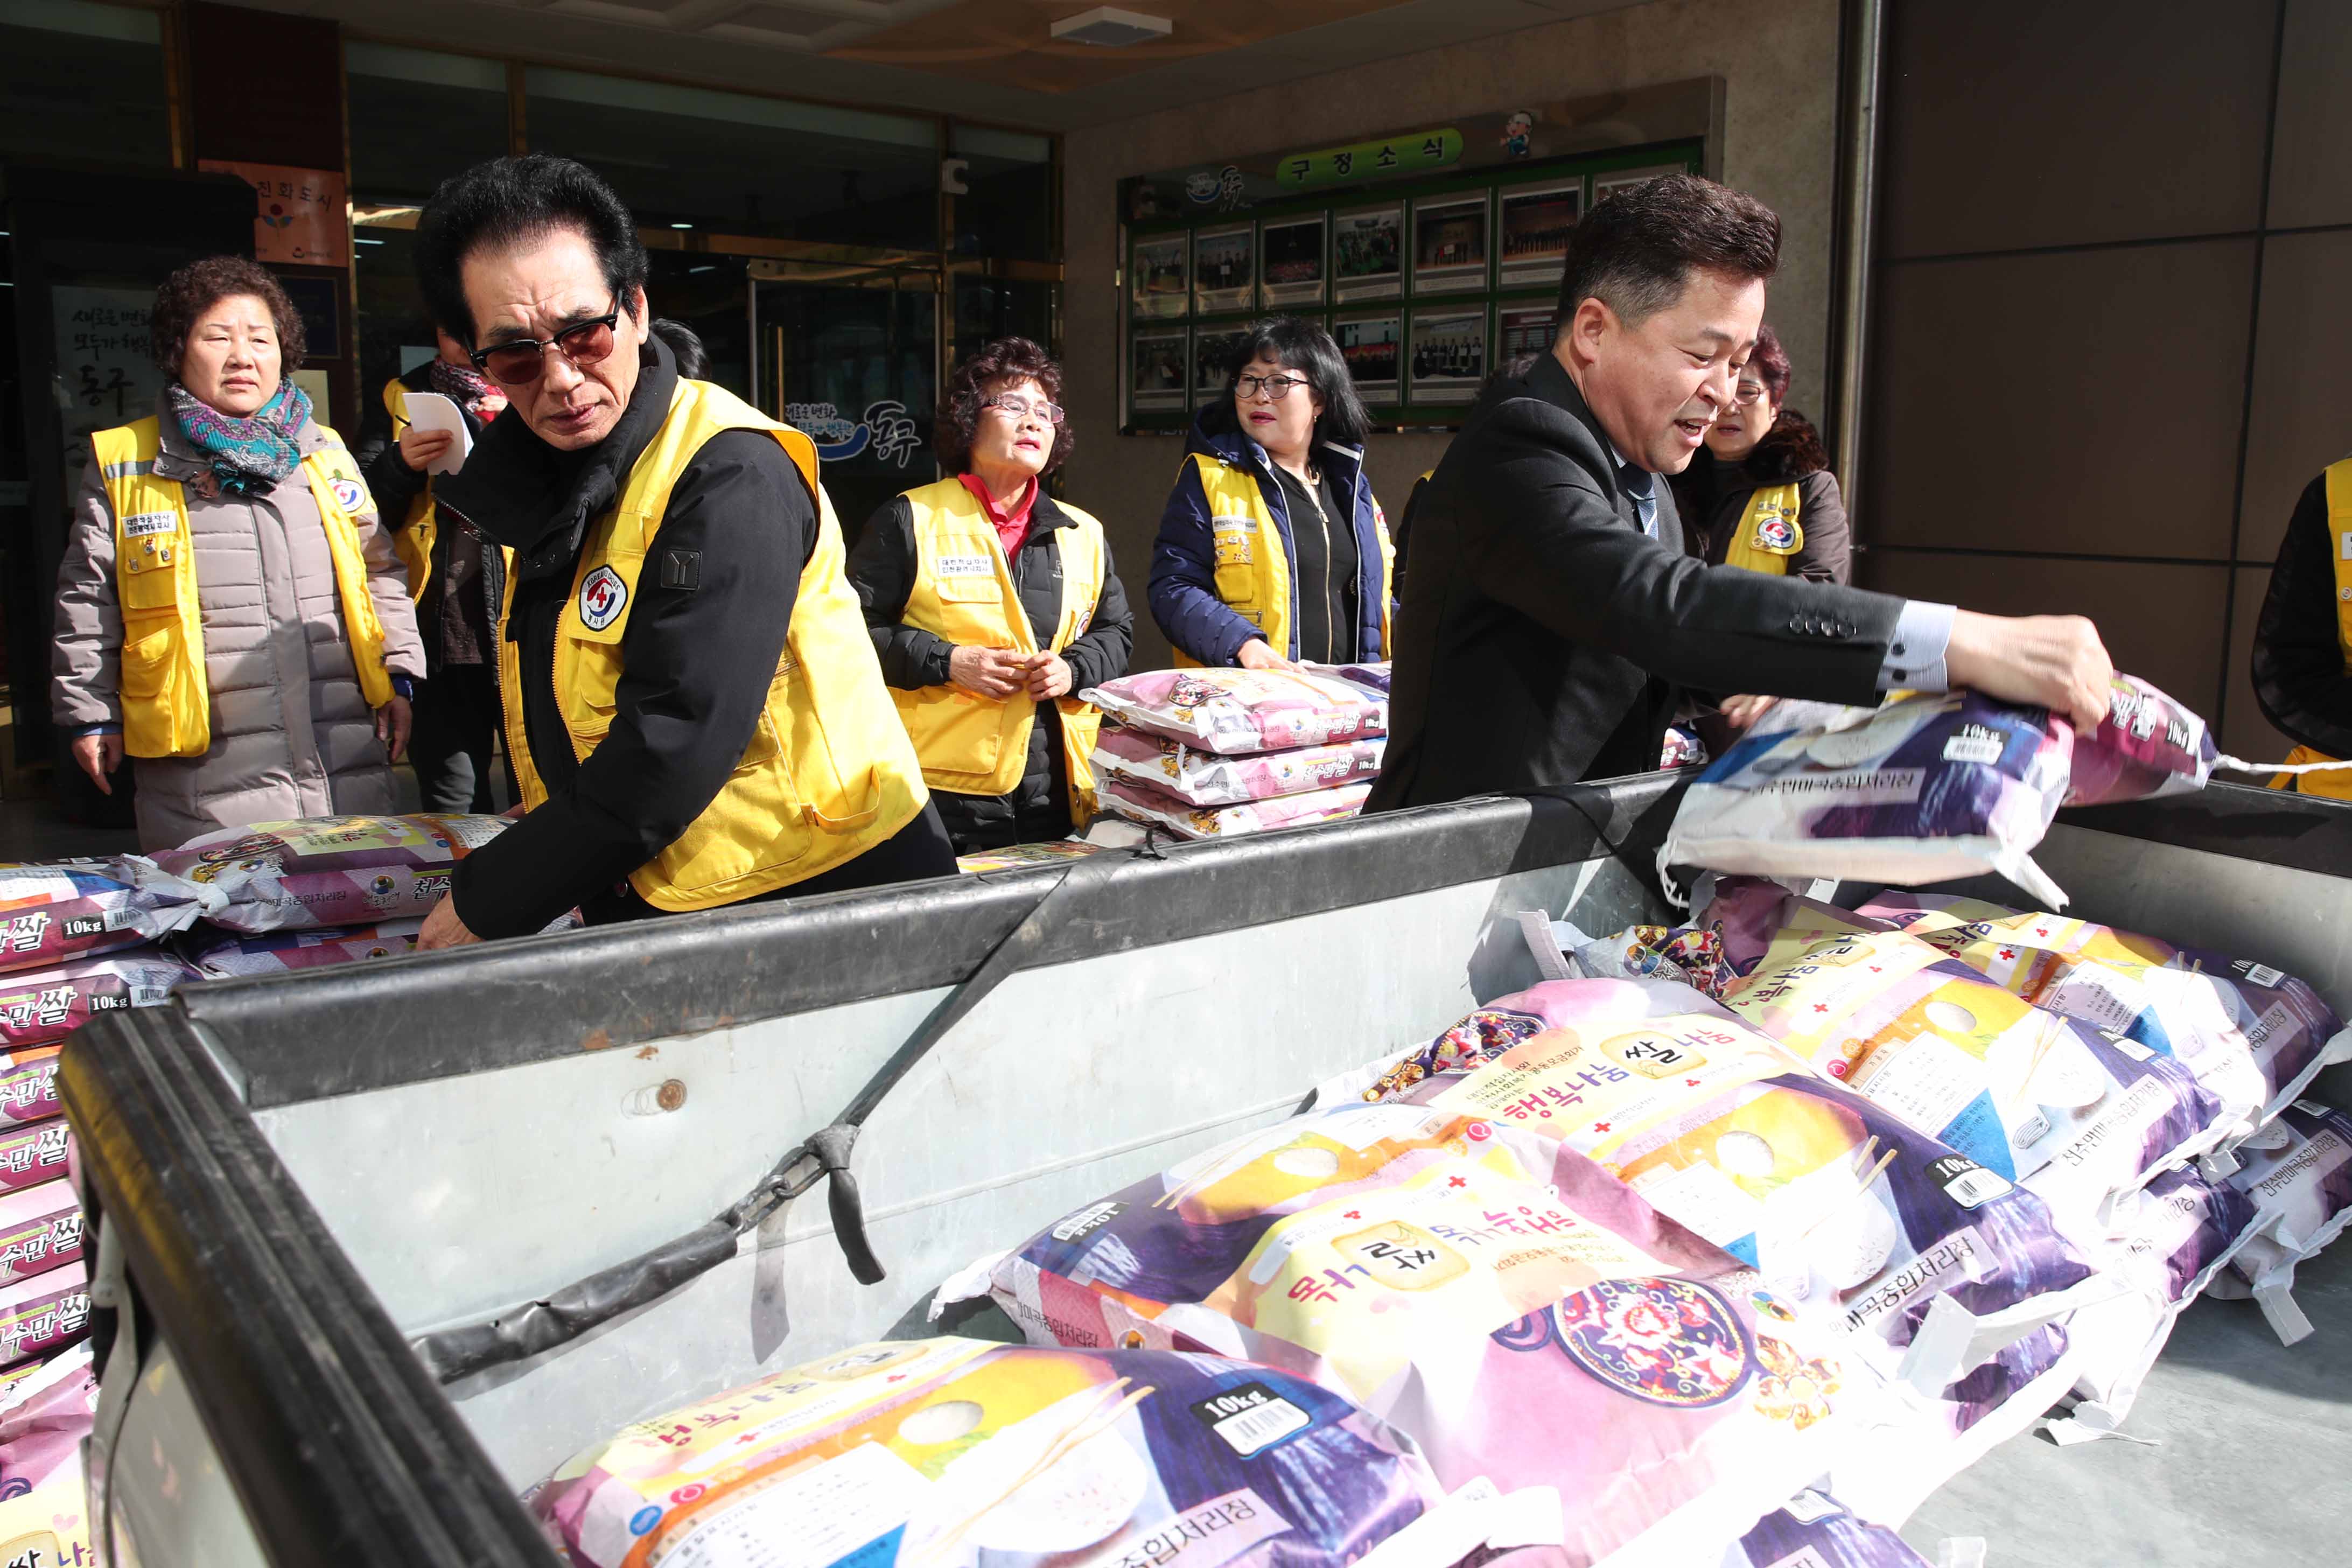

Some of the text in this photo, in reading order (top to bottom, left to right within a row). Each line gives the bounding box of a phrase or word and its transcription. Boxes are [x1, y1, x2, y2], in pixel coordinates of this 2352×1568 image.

[1291, 136, 1446, 180] 구정소식
[79, 364, 135, 416] 동구
[865, 401, 921, 467] 동구
[65, 920, 102, 936] 10kg
[2231, 959, 2256, 972] 10k
[92, 996, 128, 1011] 10kg
[1503, 1062, 1630, 1120] 행복나눔
[1935, 1158, 1980, 1178] 10kg
[0, 1293, 92, 1359] 수만쌀
[1204, 1390, 1268, 1418] 10kg
